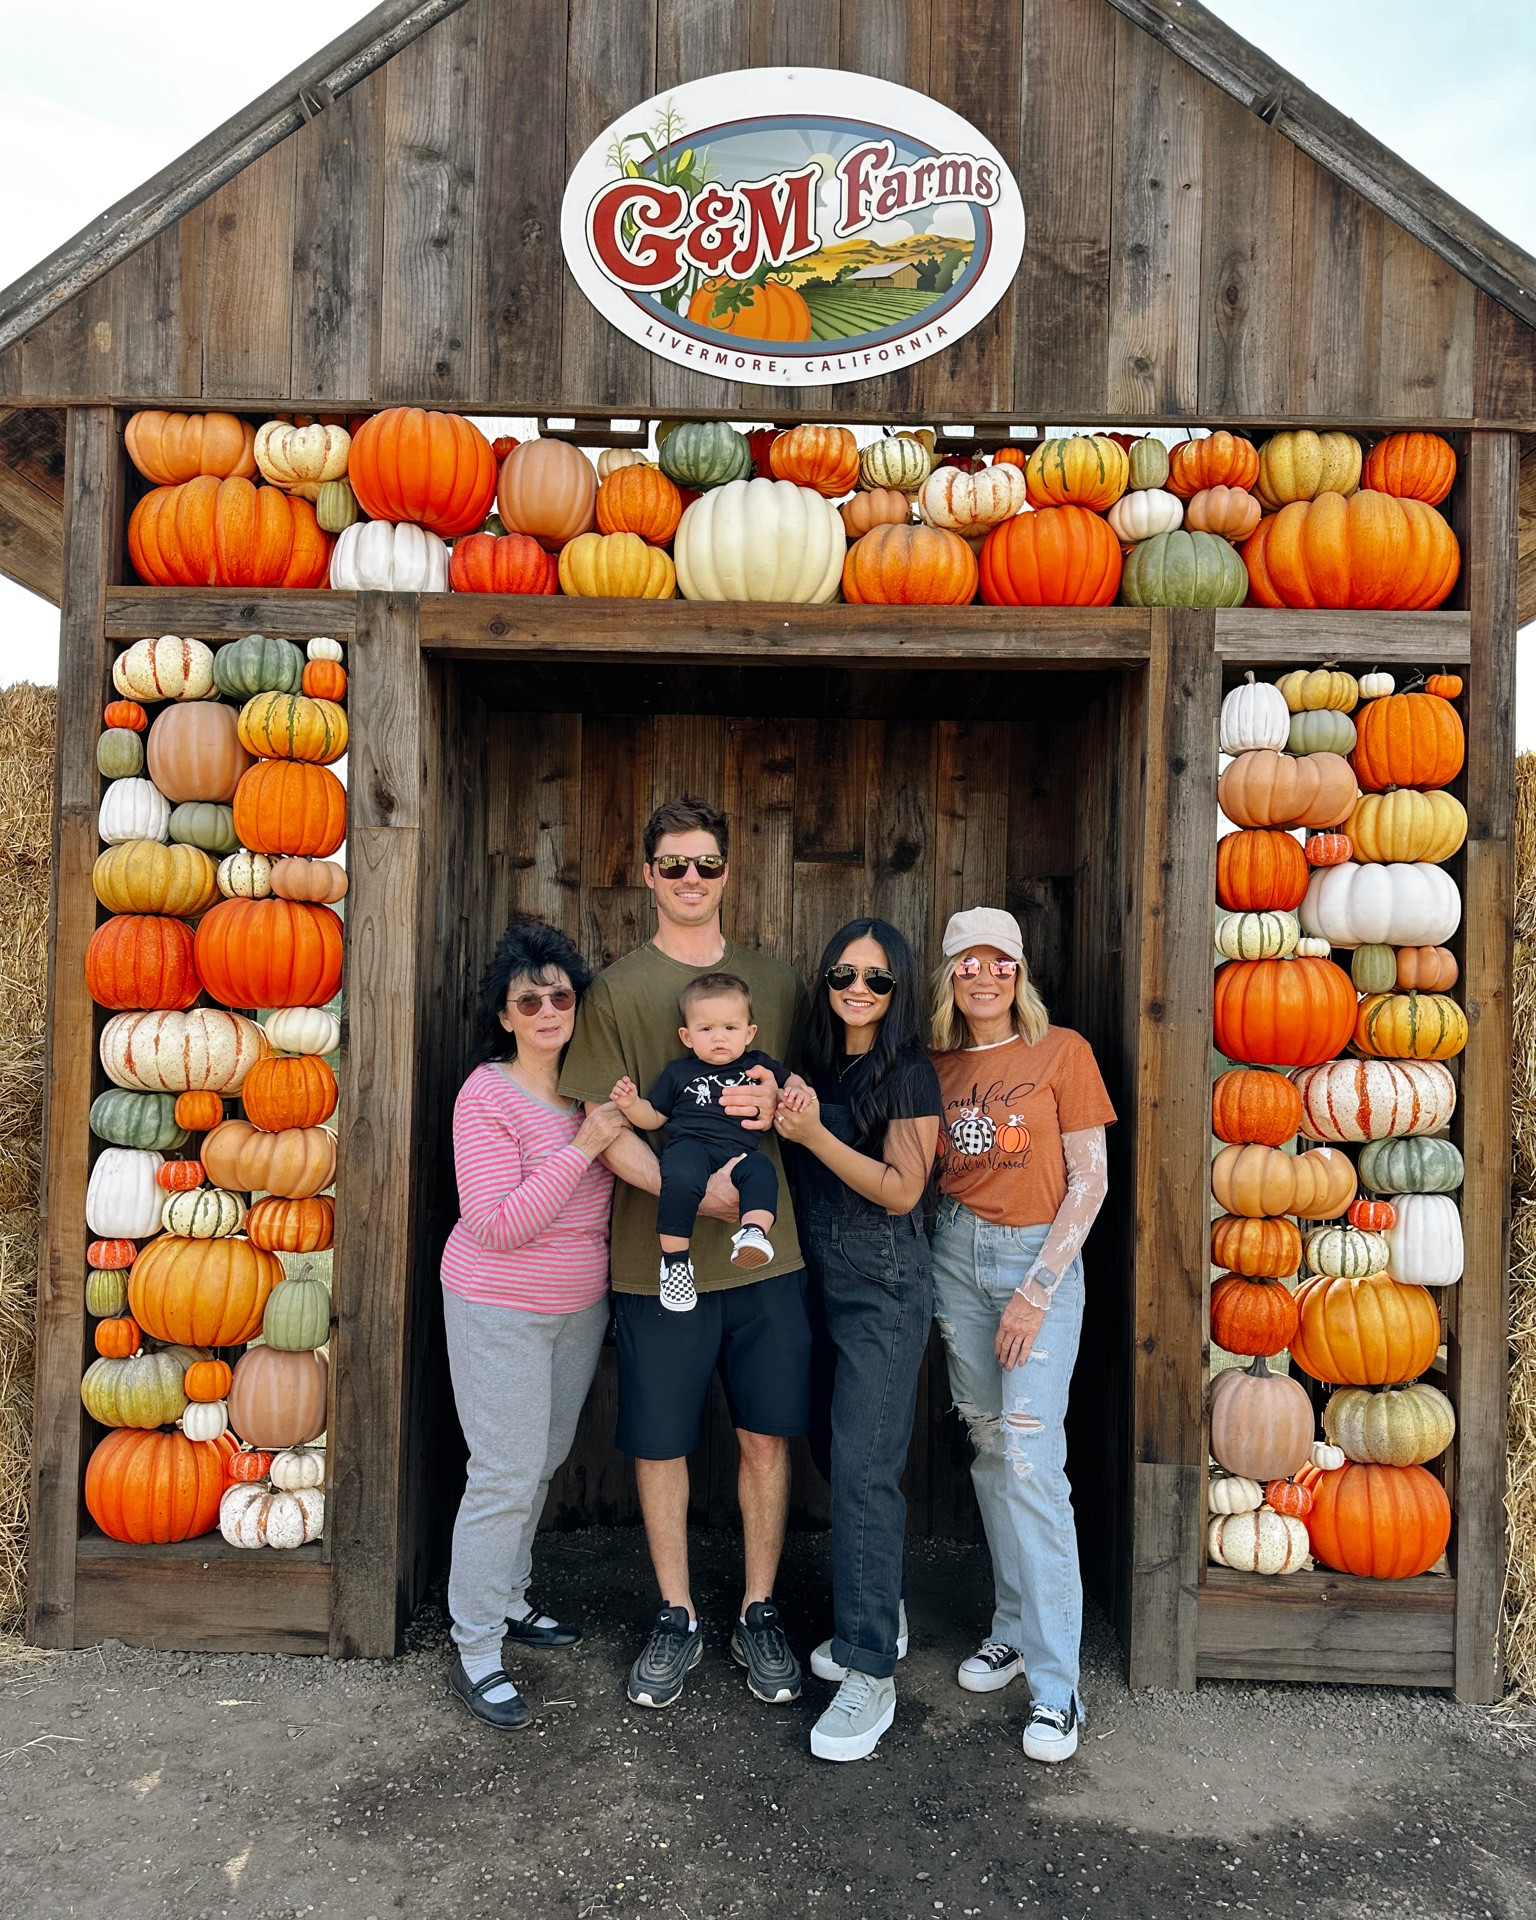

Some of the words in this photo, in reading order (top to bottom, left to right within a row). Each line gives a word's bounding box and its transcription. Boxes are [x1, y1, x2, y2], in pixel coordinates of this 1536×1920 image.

[590, 167, 819, 288] G&M
[839, 143, 995, 233] Farms
[645, 325, 788, 375] LIVERMORE,
[804, 325, 948, 373] CALIFORNIA
